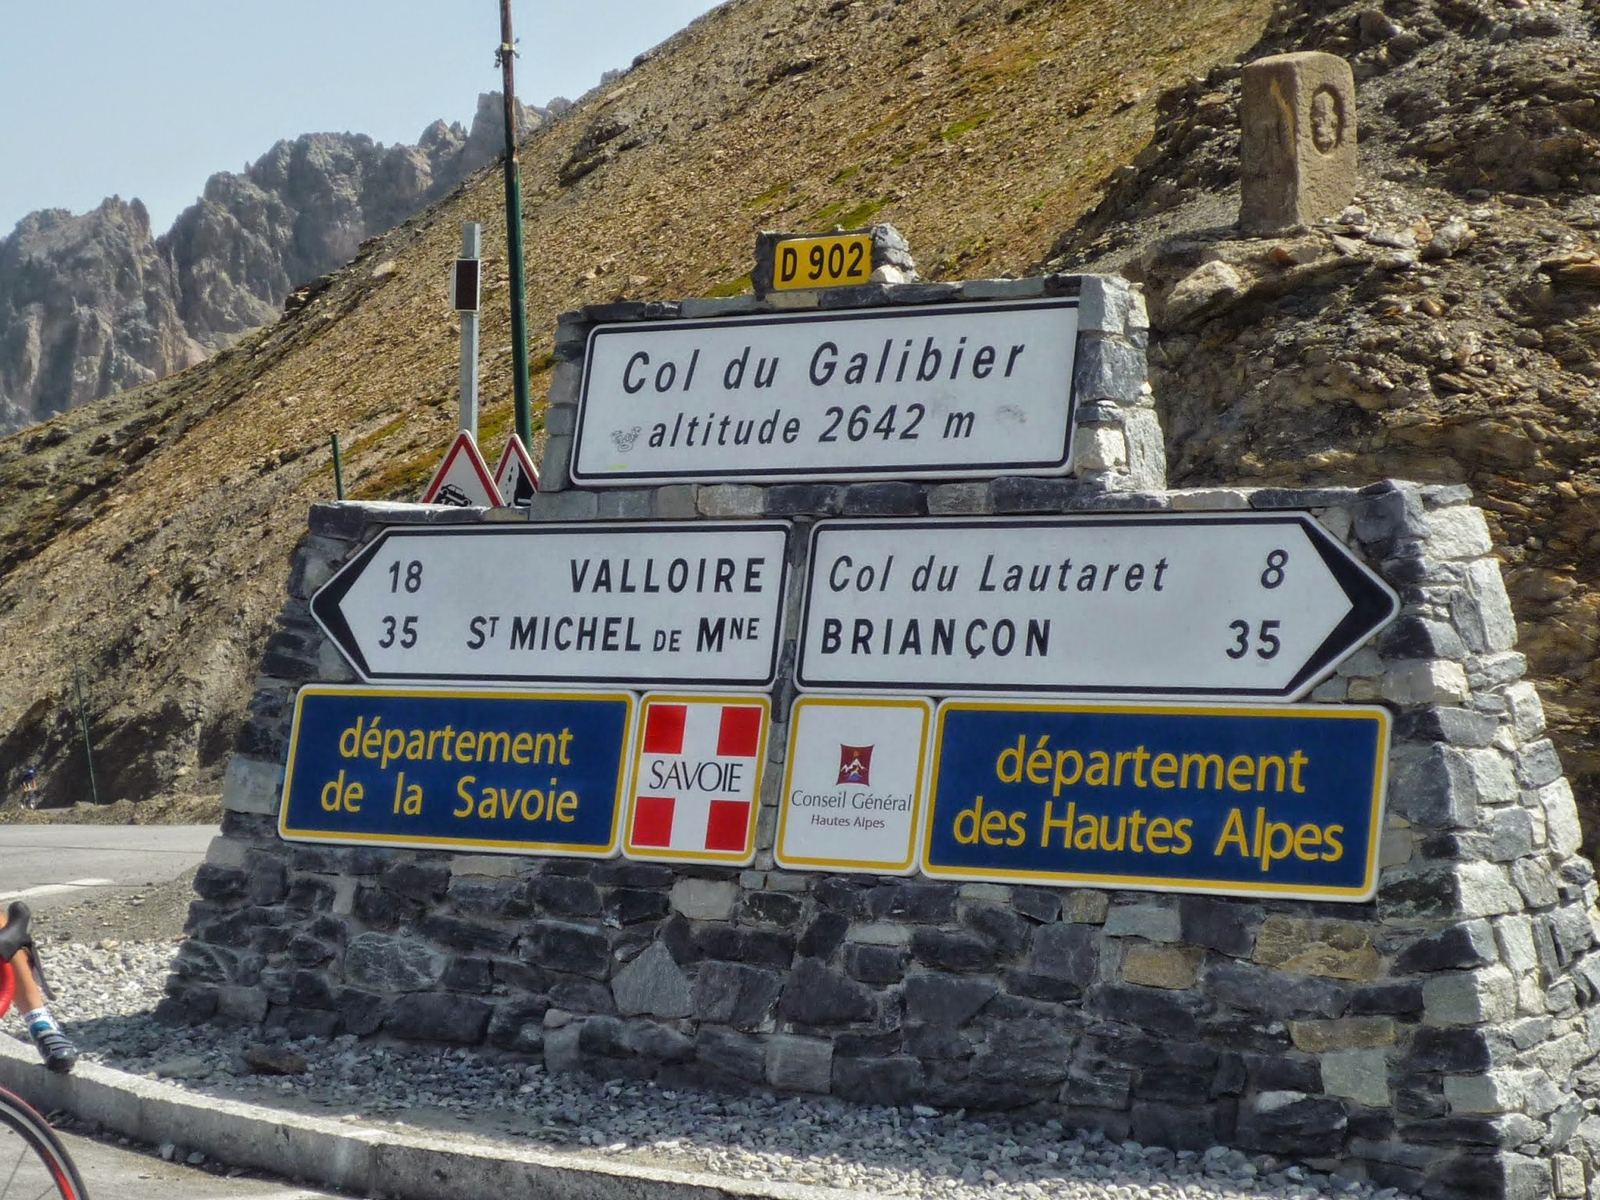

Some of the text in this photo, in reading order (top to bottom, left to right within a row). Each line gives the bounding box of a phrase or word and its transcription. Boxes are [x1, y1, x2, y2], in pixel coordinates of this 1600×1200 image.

[780, 241, 864, 283] D 902
[622, 336, 1025, 395] Col du Galibier
[648, 403, 975, 448] altitude 2642 m
[389, 557, 765, 594] 18 VALLOIRE
[829, 549, 1289, 593] Col du Lautaret 8
[378, 615, 419, 649] 35
[509, 616, 641, 652] MICHEL
[820, 618, 1281, 660] BRIANÇON 35
[339, 717, 573, 767] département
[649, 759, 744, 793] SAVOIE
[996, 736, 1308, 795] département
[321, 771, 578, 822] de la Savoie
[791, 789, 912, 812] Conseil Général
[810, 813, 886, 831] Hautes Alpes
[953, 797, 1343, 871] des Hautes Alpes
